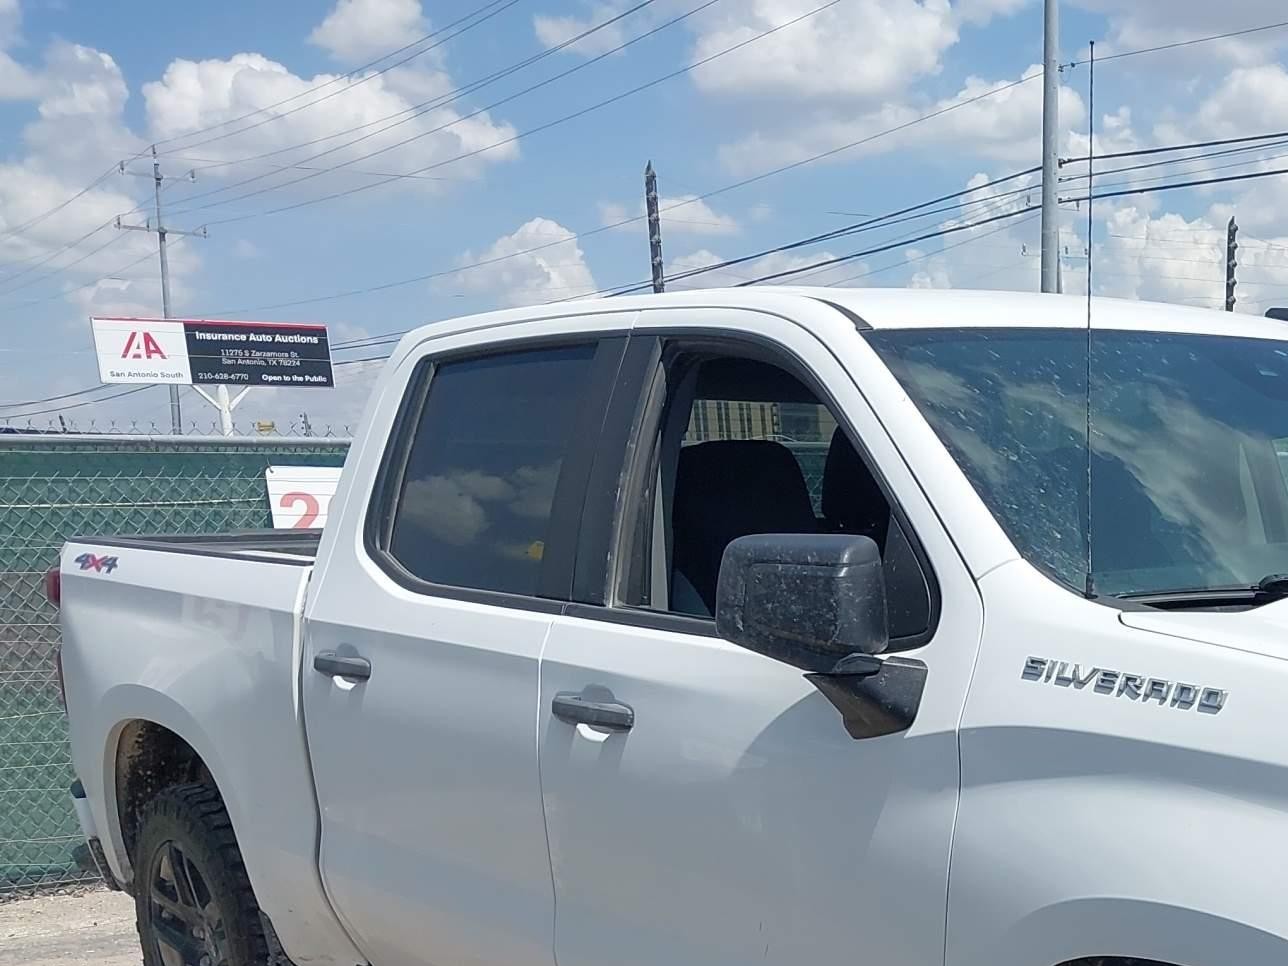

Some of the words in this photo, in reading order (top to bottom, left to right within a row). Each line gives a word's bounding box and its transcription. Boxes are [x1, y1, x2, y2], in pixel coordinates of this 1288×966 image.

[195, 331, 247, 342] Insurance
[249, 332, 273, 343] Auto
[274, 334, 319, 345] Auctions
[251, 350, 289, 358] Zarzamora
[268, 359, 278, 367] TX
[109, 370, 126, 378] San
[160, 371, 184, 379] South
[261, 374, 282, 384] Open
[283, 374, 292, 382] to
[292, 374, 304, 383] the
[304, 375, 328, 383] Public
[279, 491, 320, 529] 2
[1021, 655, 1229, 715] SILVERADO
